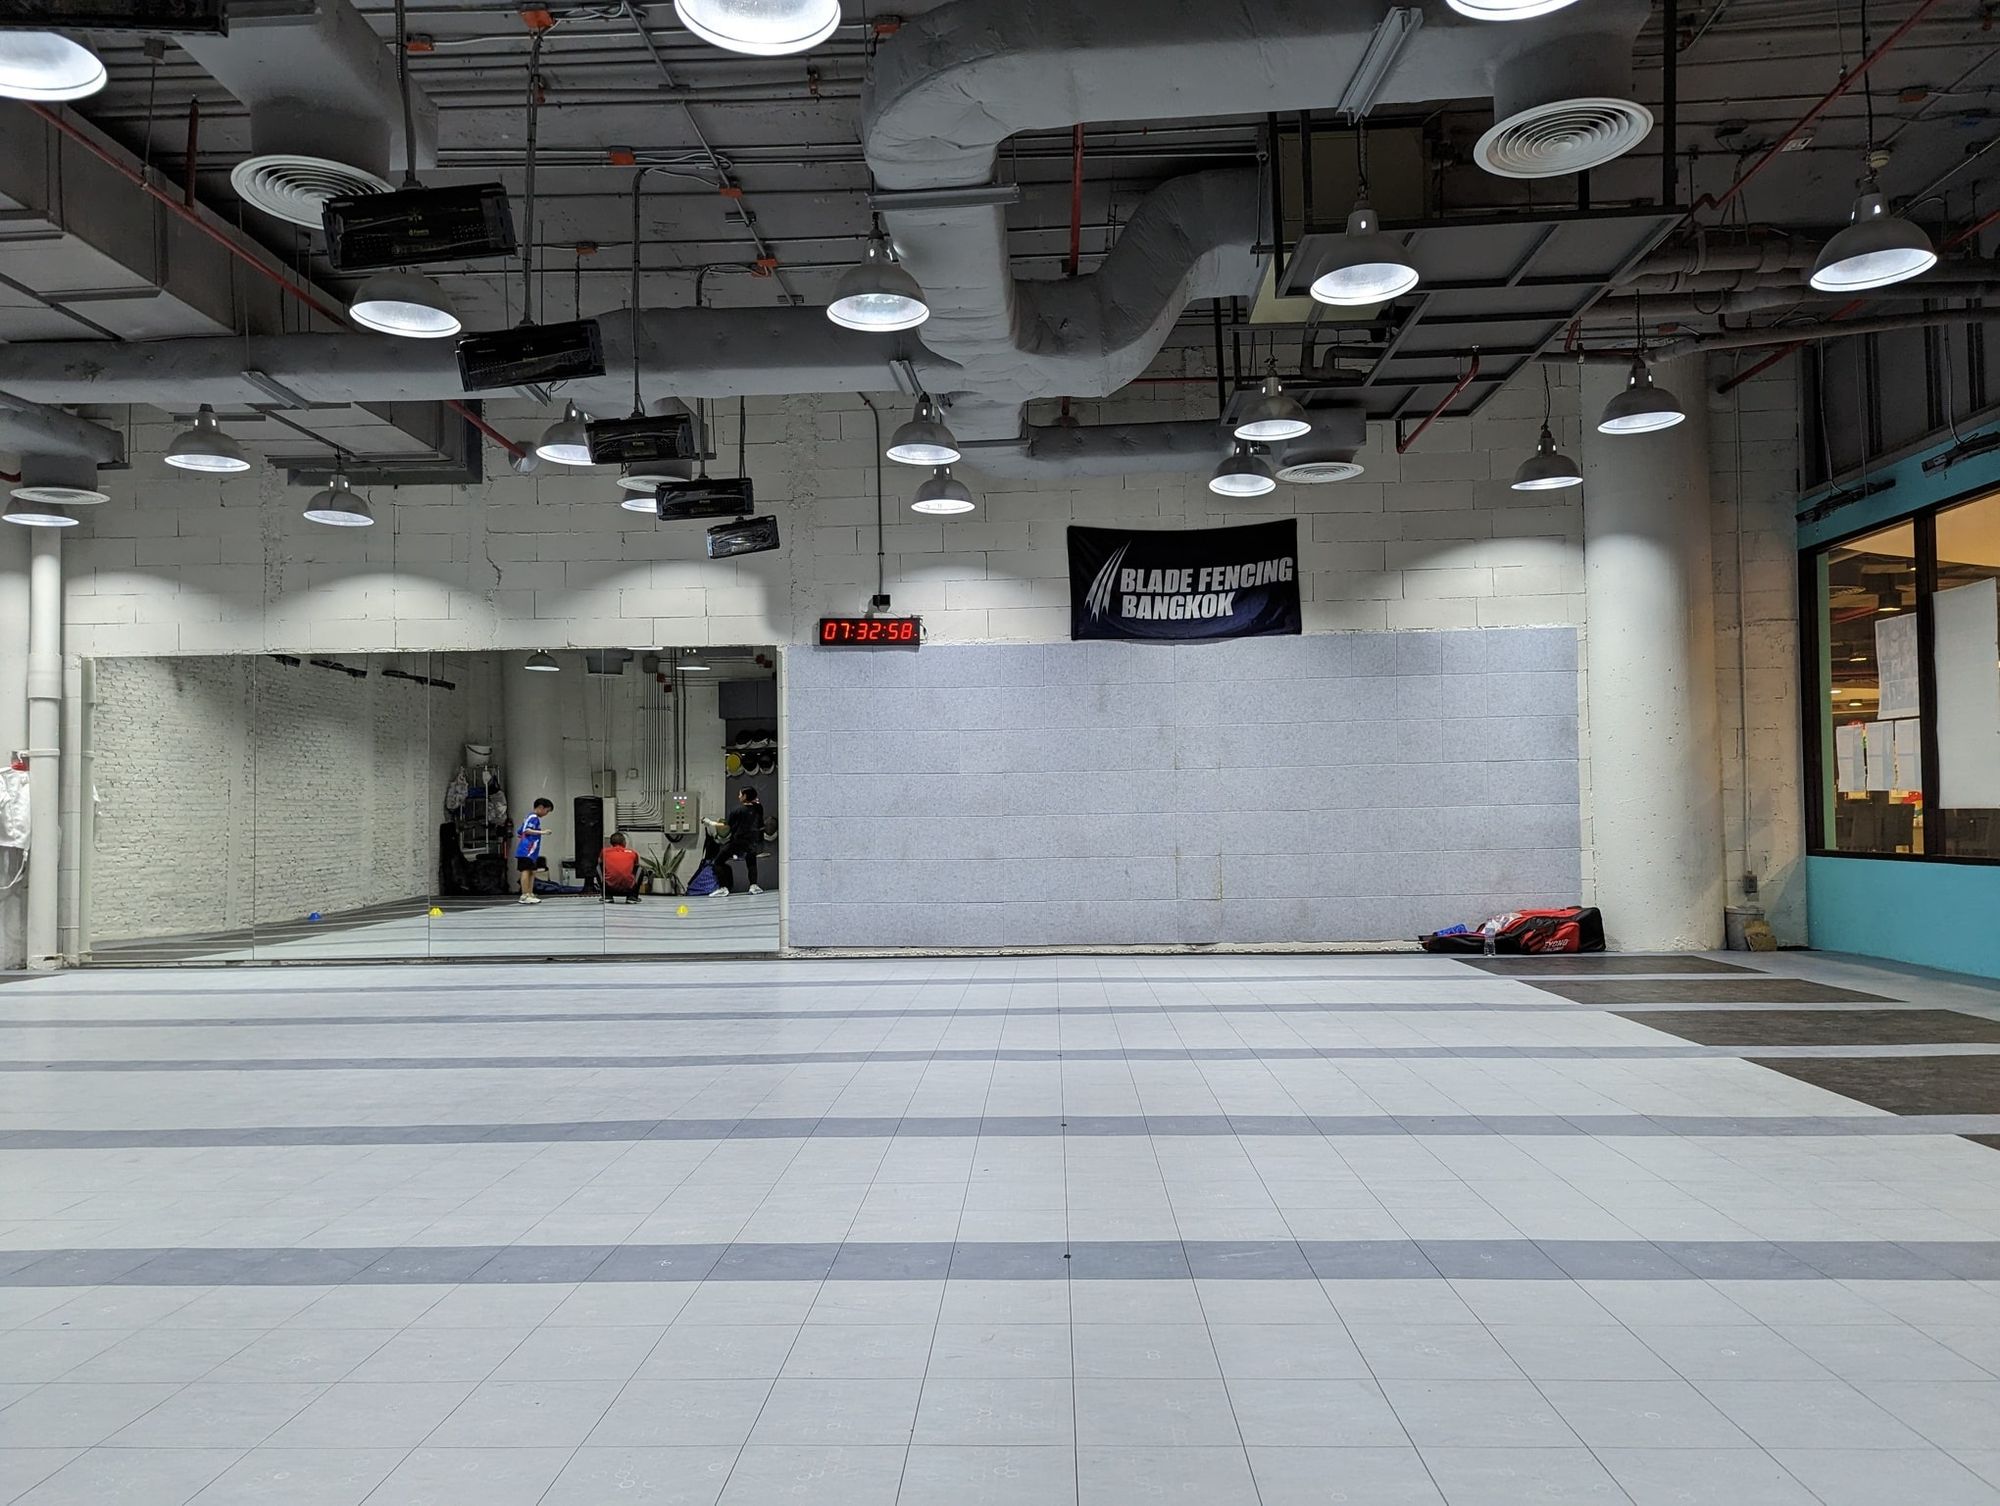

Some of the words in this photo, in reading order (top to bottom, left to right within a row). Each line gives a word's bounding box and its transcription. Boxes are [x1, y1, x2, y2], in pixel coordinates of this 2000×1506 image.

[1119, 568, 1194, 593] BLADE
[1198, 556, 1294, 592] FENCING
[1121, 591, 1236, 620] BANGKOK
[824, 622, 913, 640] 07:32:58
